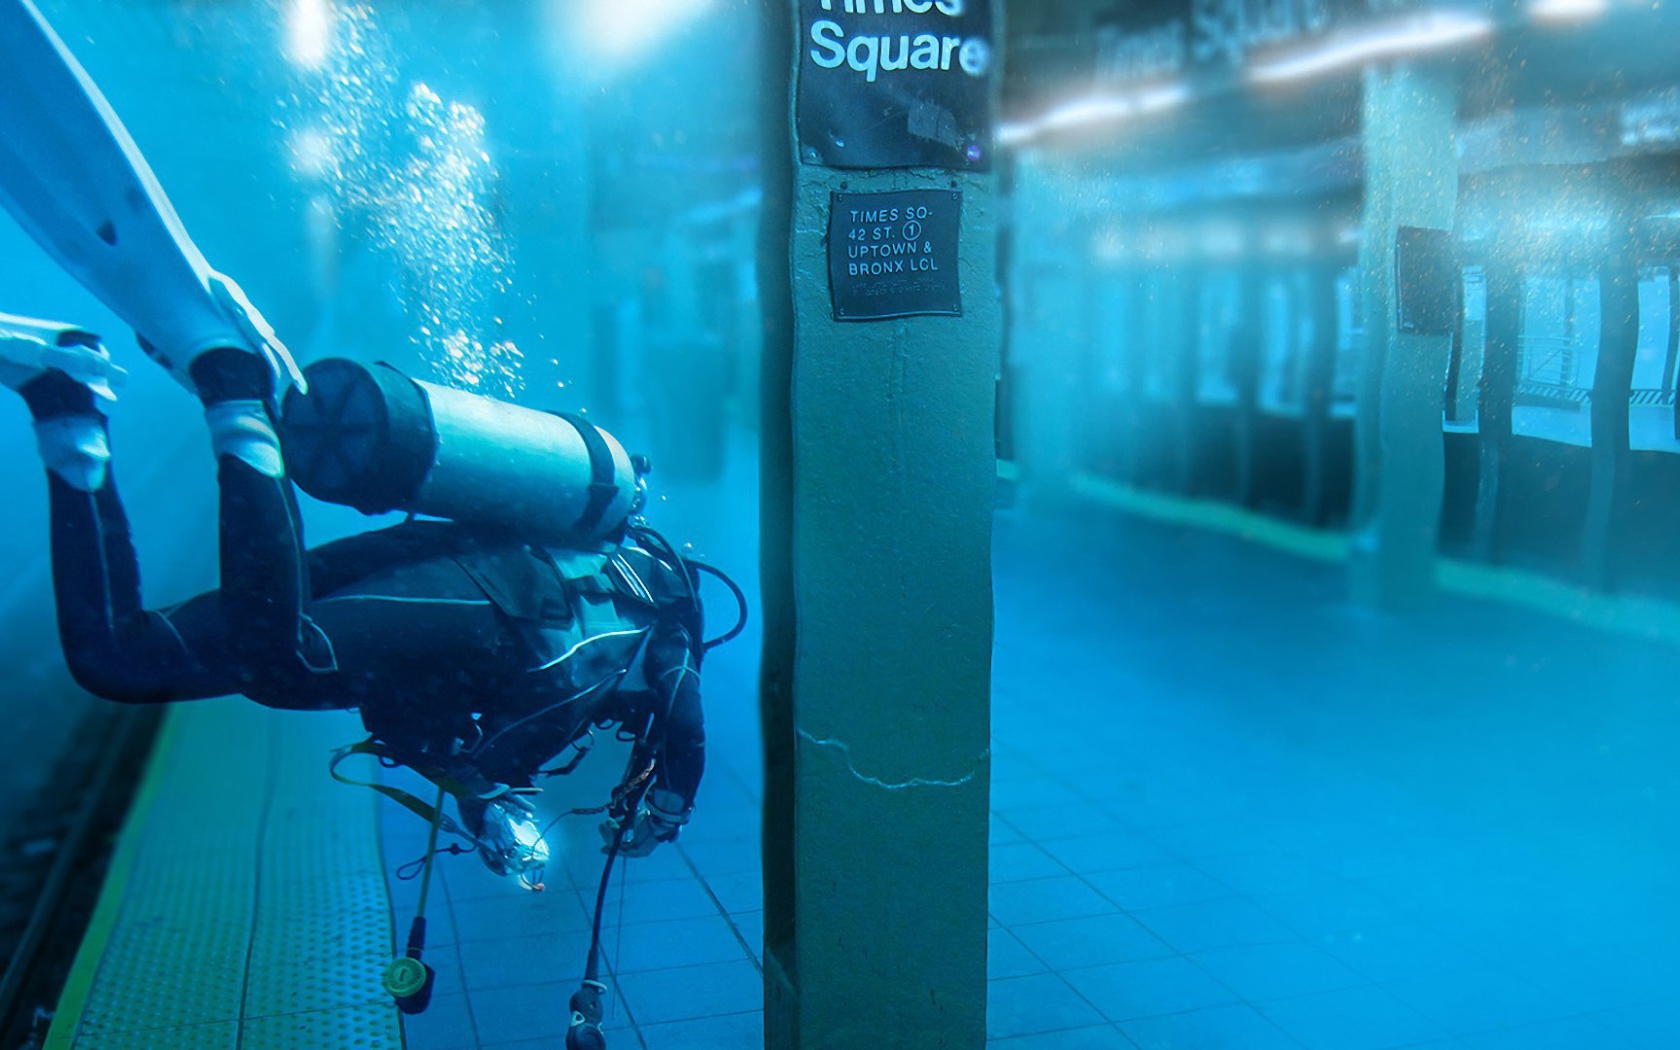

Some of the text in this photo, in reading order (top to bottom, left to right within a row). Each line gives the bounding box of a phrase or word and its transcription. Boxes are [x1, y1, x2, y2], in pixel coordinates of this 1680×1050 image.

[810, 20, 989, 83] Square
[850, 208, 899, 223] TIMES
[848, 228, 866, 241] 42
[872, 226, 895, 240] ST.
[848, 240, 932, 259] UPTOWN &
[848, 258, 939, 276] BRONX LCL
